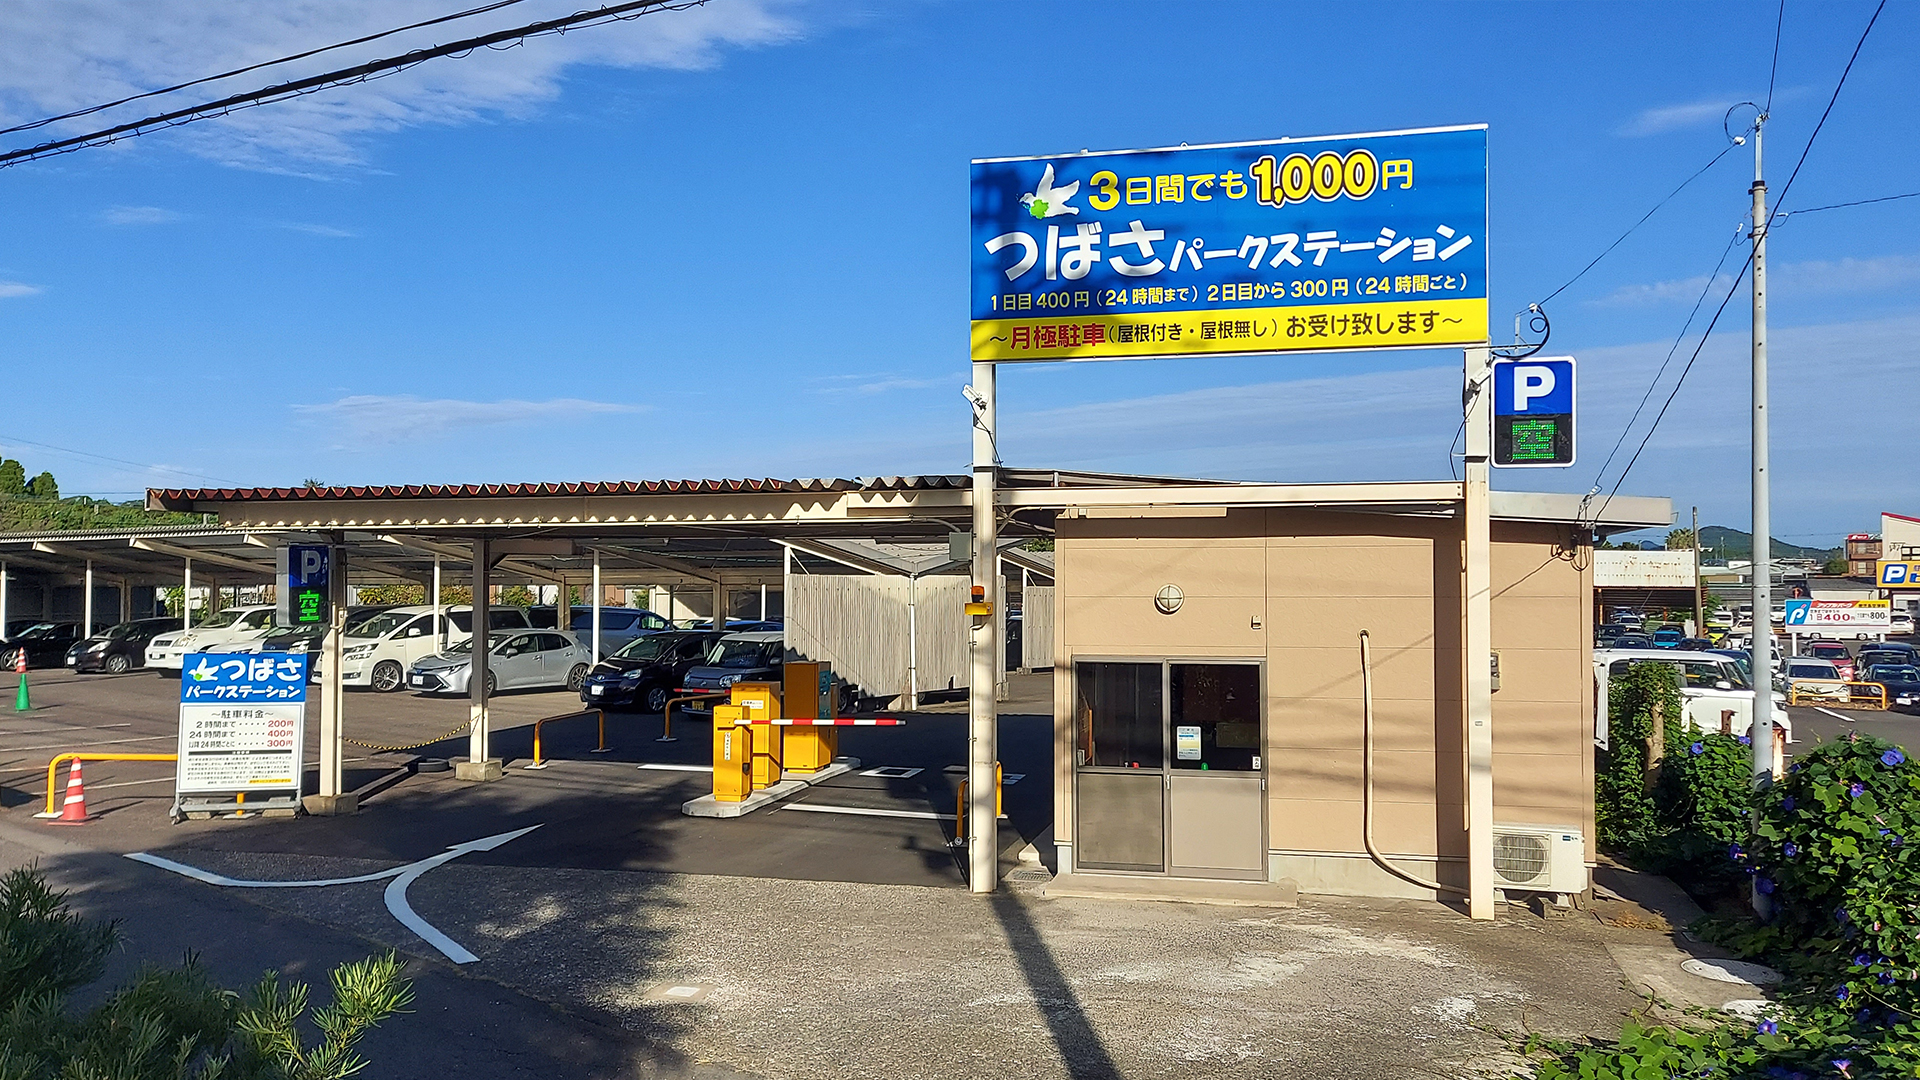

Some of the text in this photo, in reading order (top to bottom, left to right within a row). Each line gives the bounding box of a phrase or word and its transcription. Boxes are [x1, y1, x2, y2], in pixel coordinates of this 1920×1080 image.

[1514, 366, 1556, 411] P
[1512, 420, 1555, 459] 空
[301, 550, 321, 584] P
[1885, 565, 1906, 582] P
[299, 590, 320, 621] 空
[220, 658, 302, 681] つばさ
[185, 685, 301, 699] パークステーション
